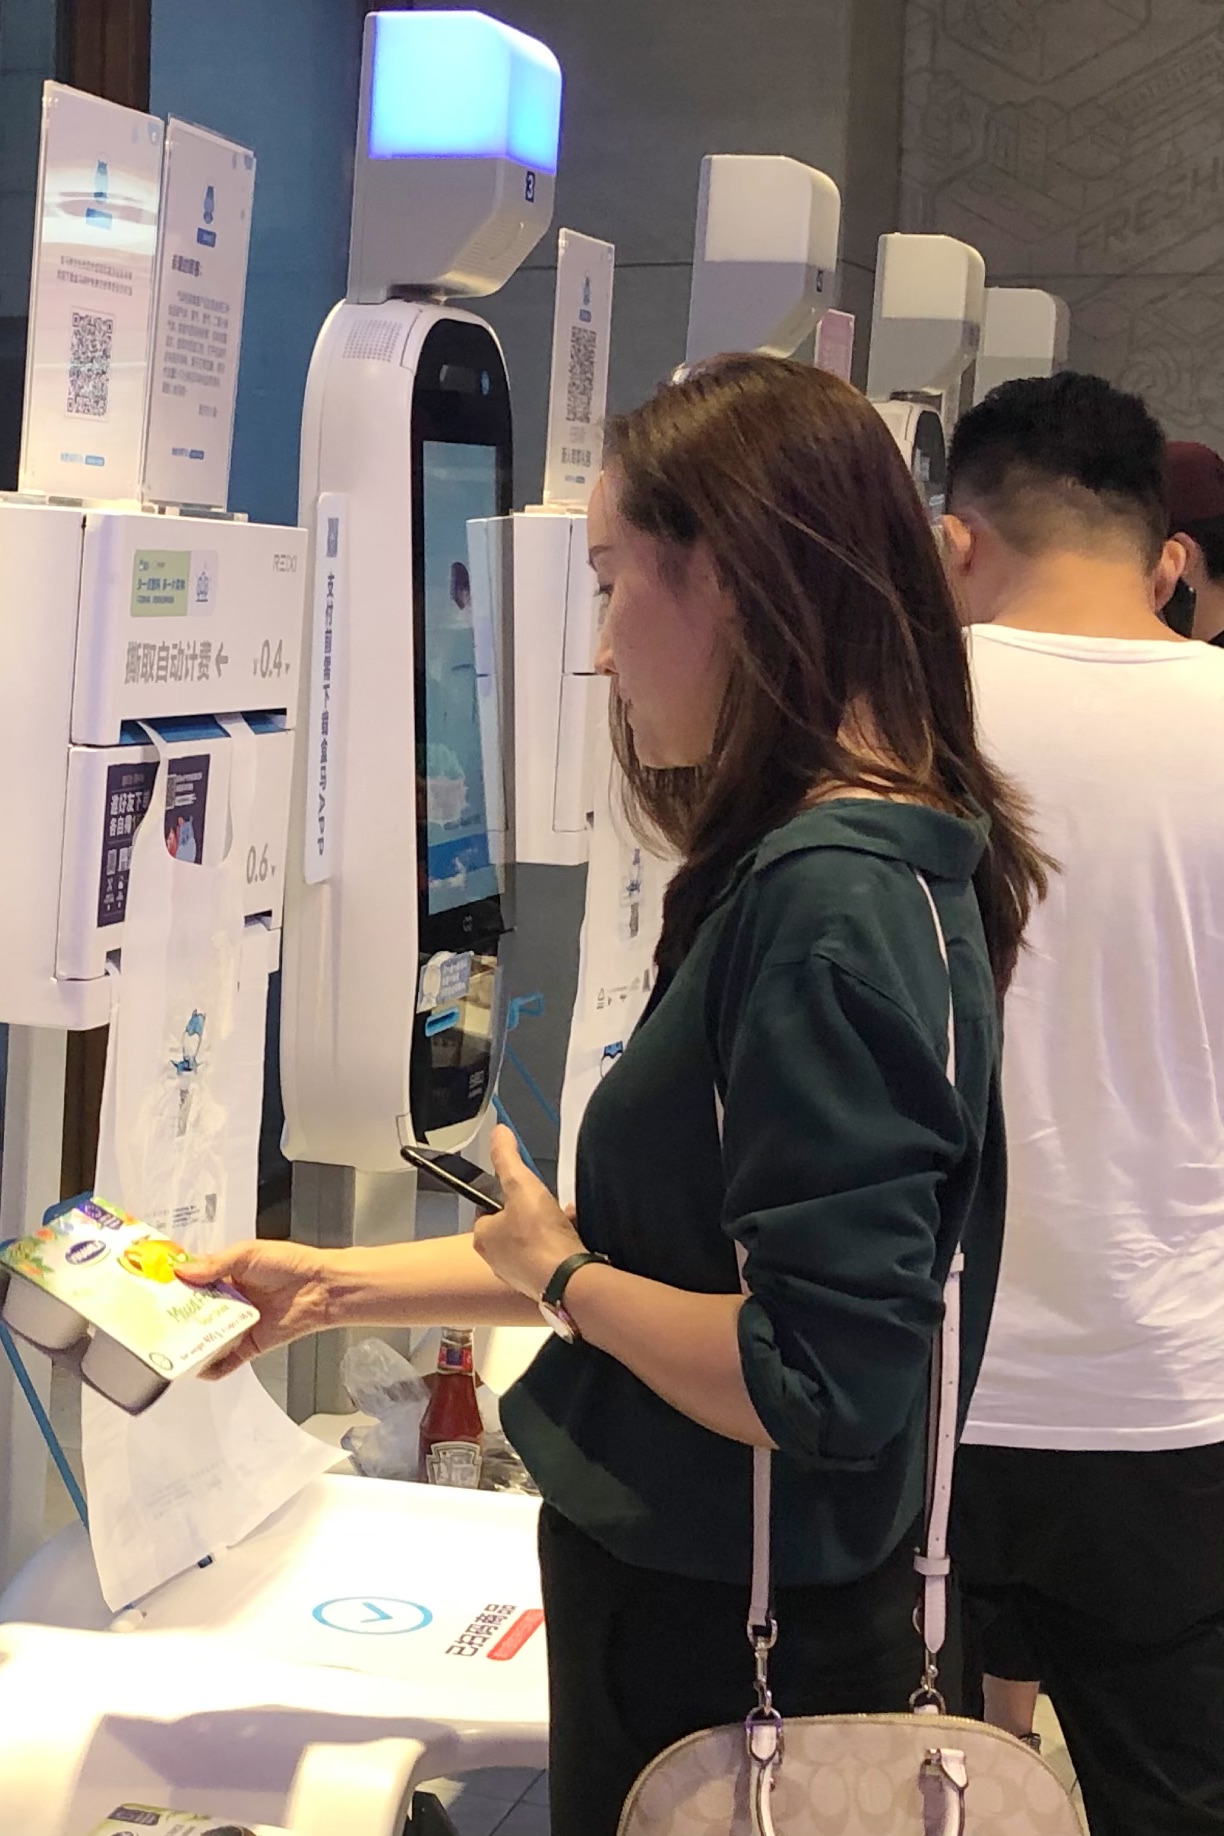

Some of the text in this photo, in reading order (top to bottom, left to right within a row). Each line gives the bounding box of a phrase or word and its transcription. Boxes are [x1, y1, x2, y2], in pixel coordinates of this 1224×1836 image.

[124, 640, 212, 684] 撕取自动计费
[246, 843, 269, 885] 0.6
